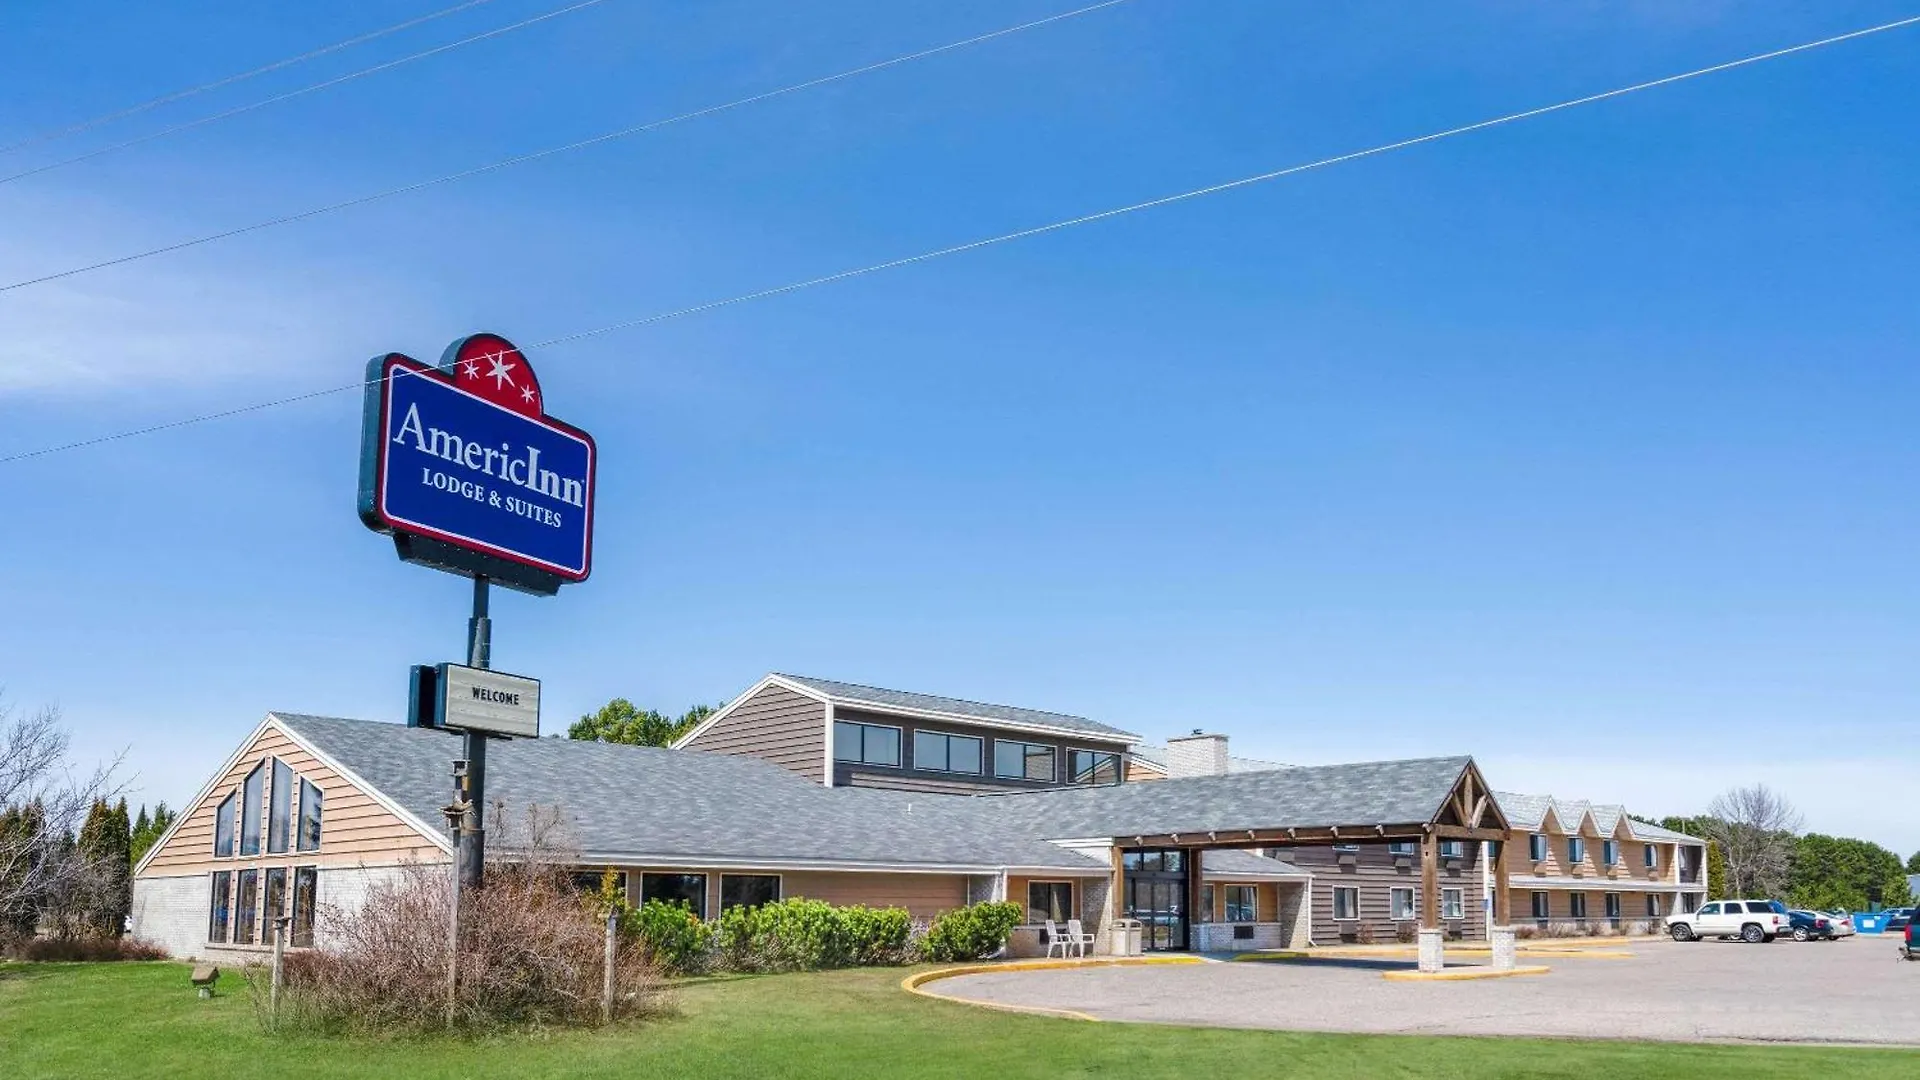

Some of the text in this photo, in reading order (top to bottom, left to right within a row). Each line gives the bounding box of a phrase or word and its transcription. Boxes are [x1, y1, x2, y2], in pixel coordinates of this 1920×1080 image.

[392, 402, 583, 508] AmericInn
[422, 467, 562, 528] LODGE & SUITES
[472, 687, 519, 705] WELCOME
